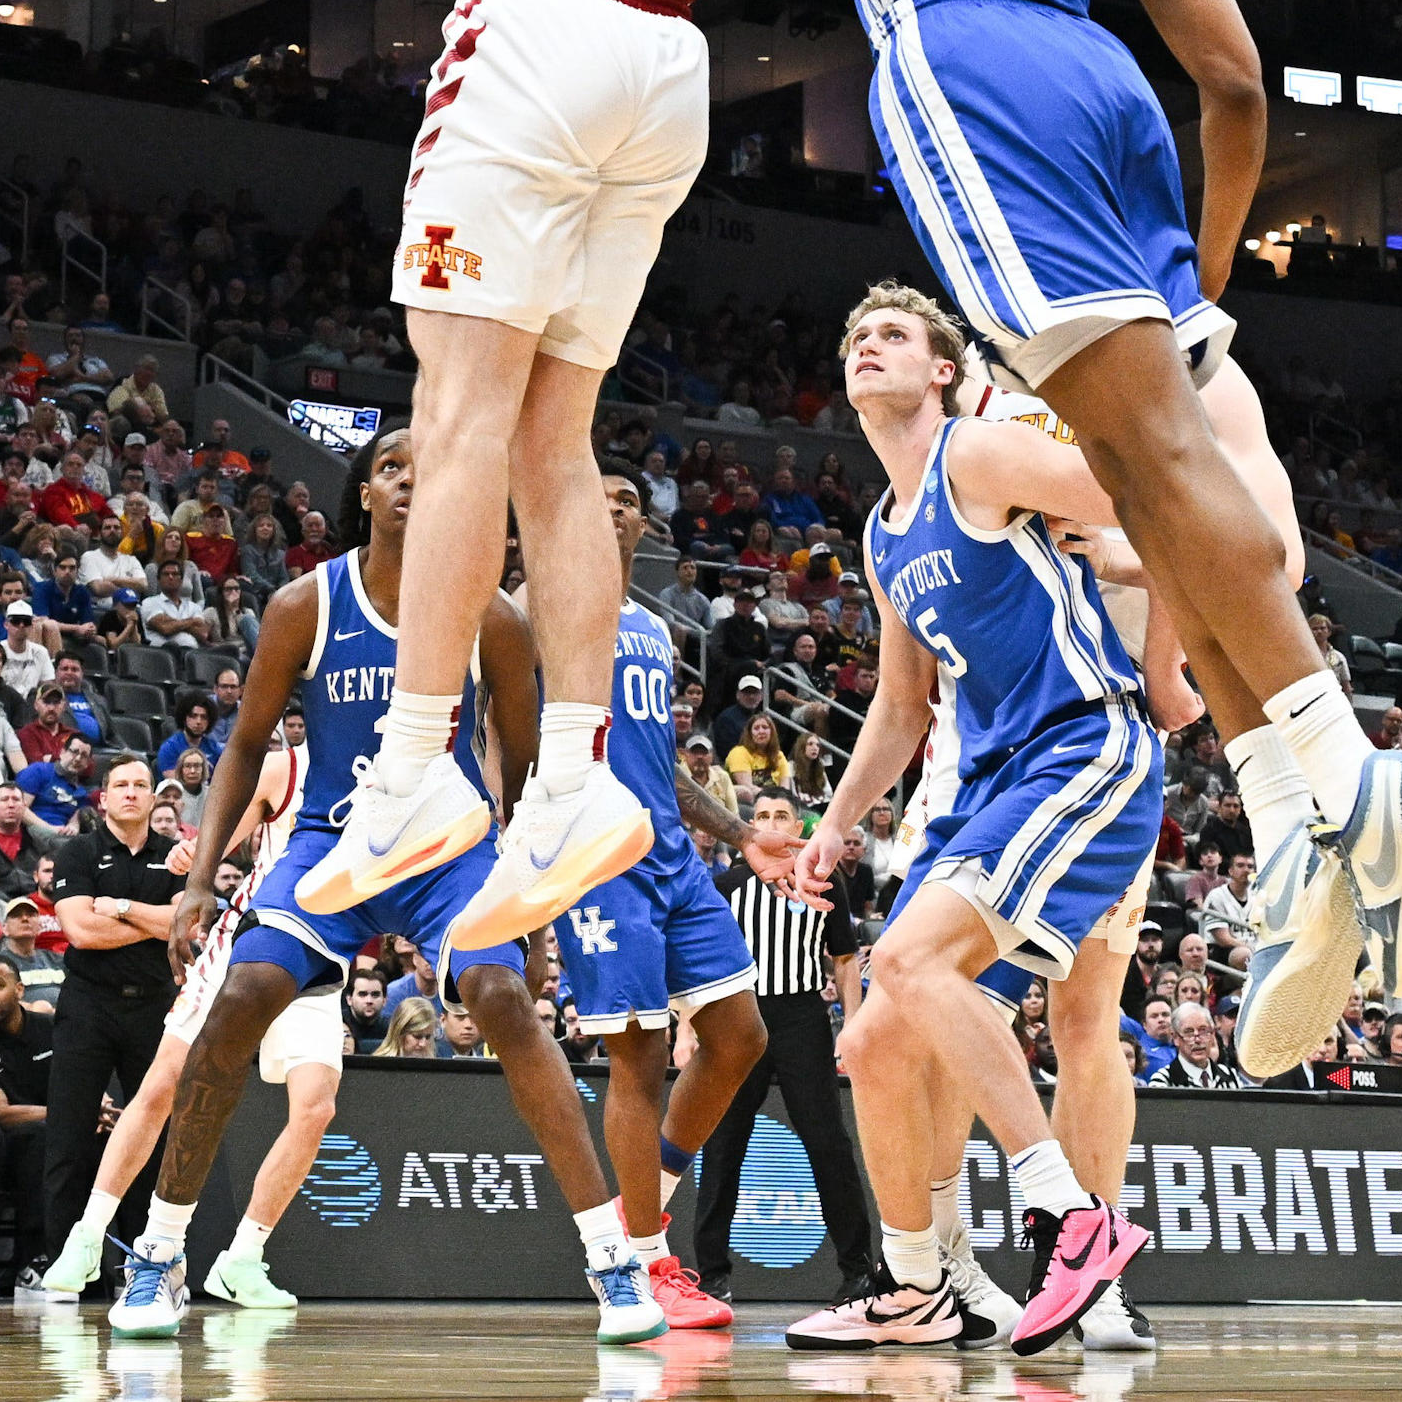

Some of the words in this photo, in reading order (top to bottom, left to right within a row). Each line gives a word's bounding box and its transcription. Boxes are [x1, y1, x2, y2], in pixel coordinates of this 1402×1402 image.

[403, 243, 483, 282] STATE
[889, 548, 962, 617] ENTUCKY
[915, 606, 968, 679] 5
[325, 666, 396, 704] KENT
[623, 664, 670, 724] 00
[568, 906, 618, 956] UK
[1352, 1069, 1378, 1087] POSS.
[397, 1151, 545, 1214] AT&T
